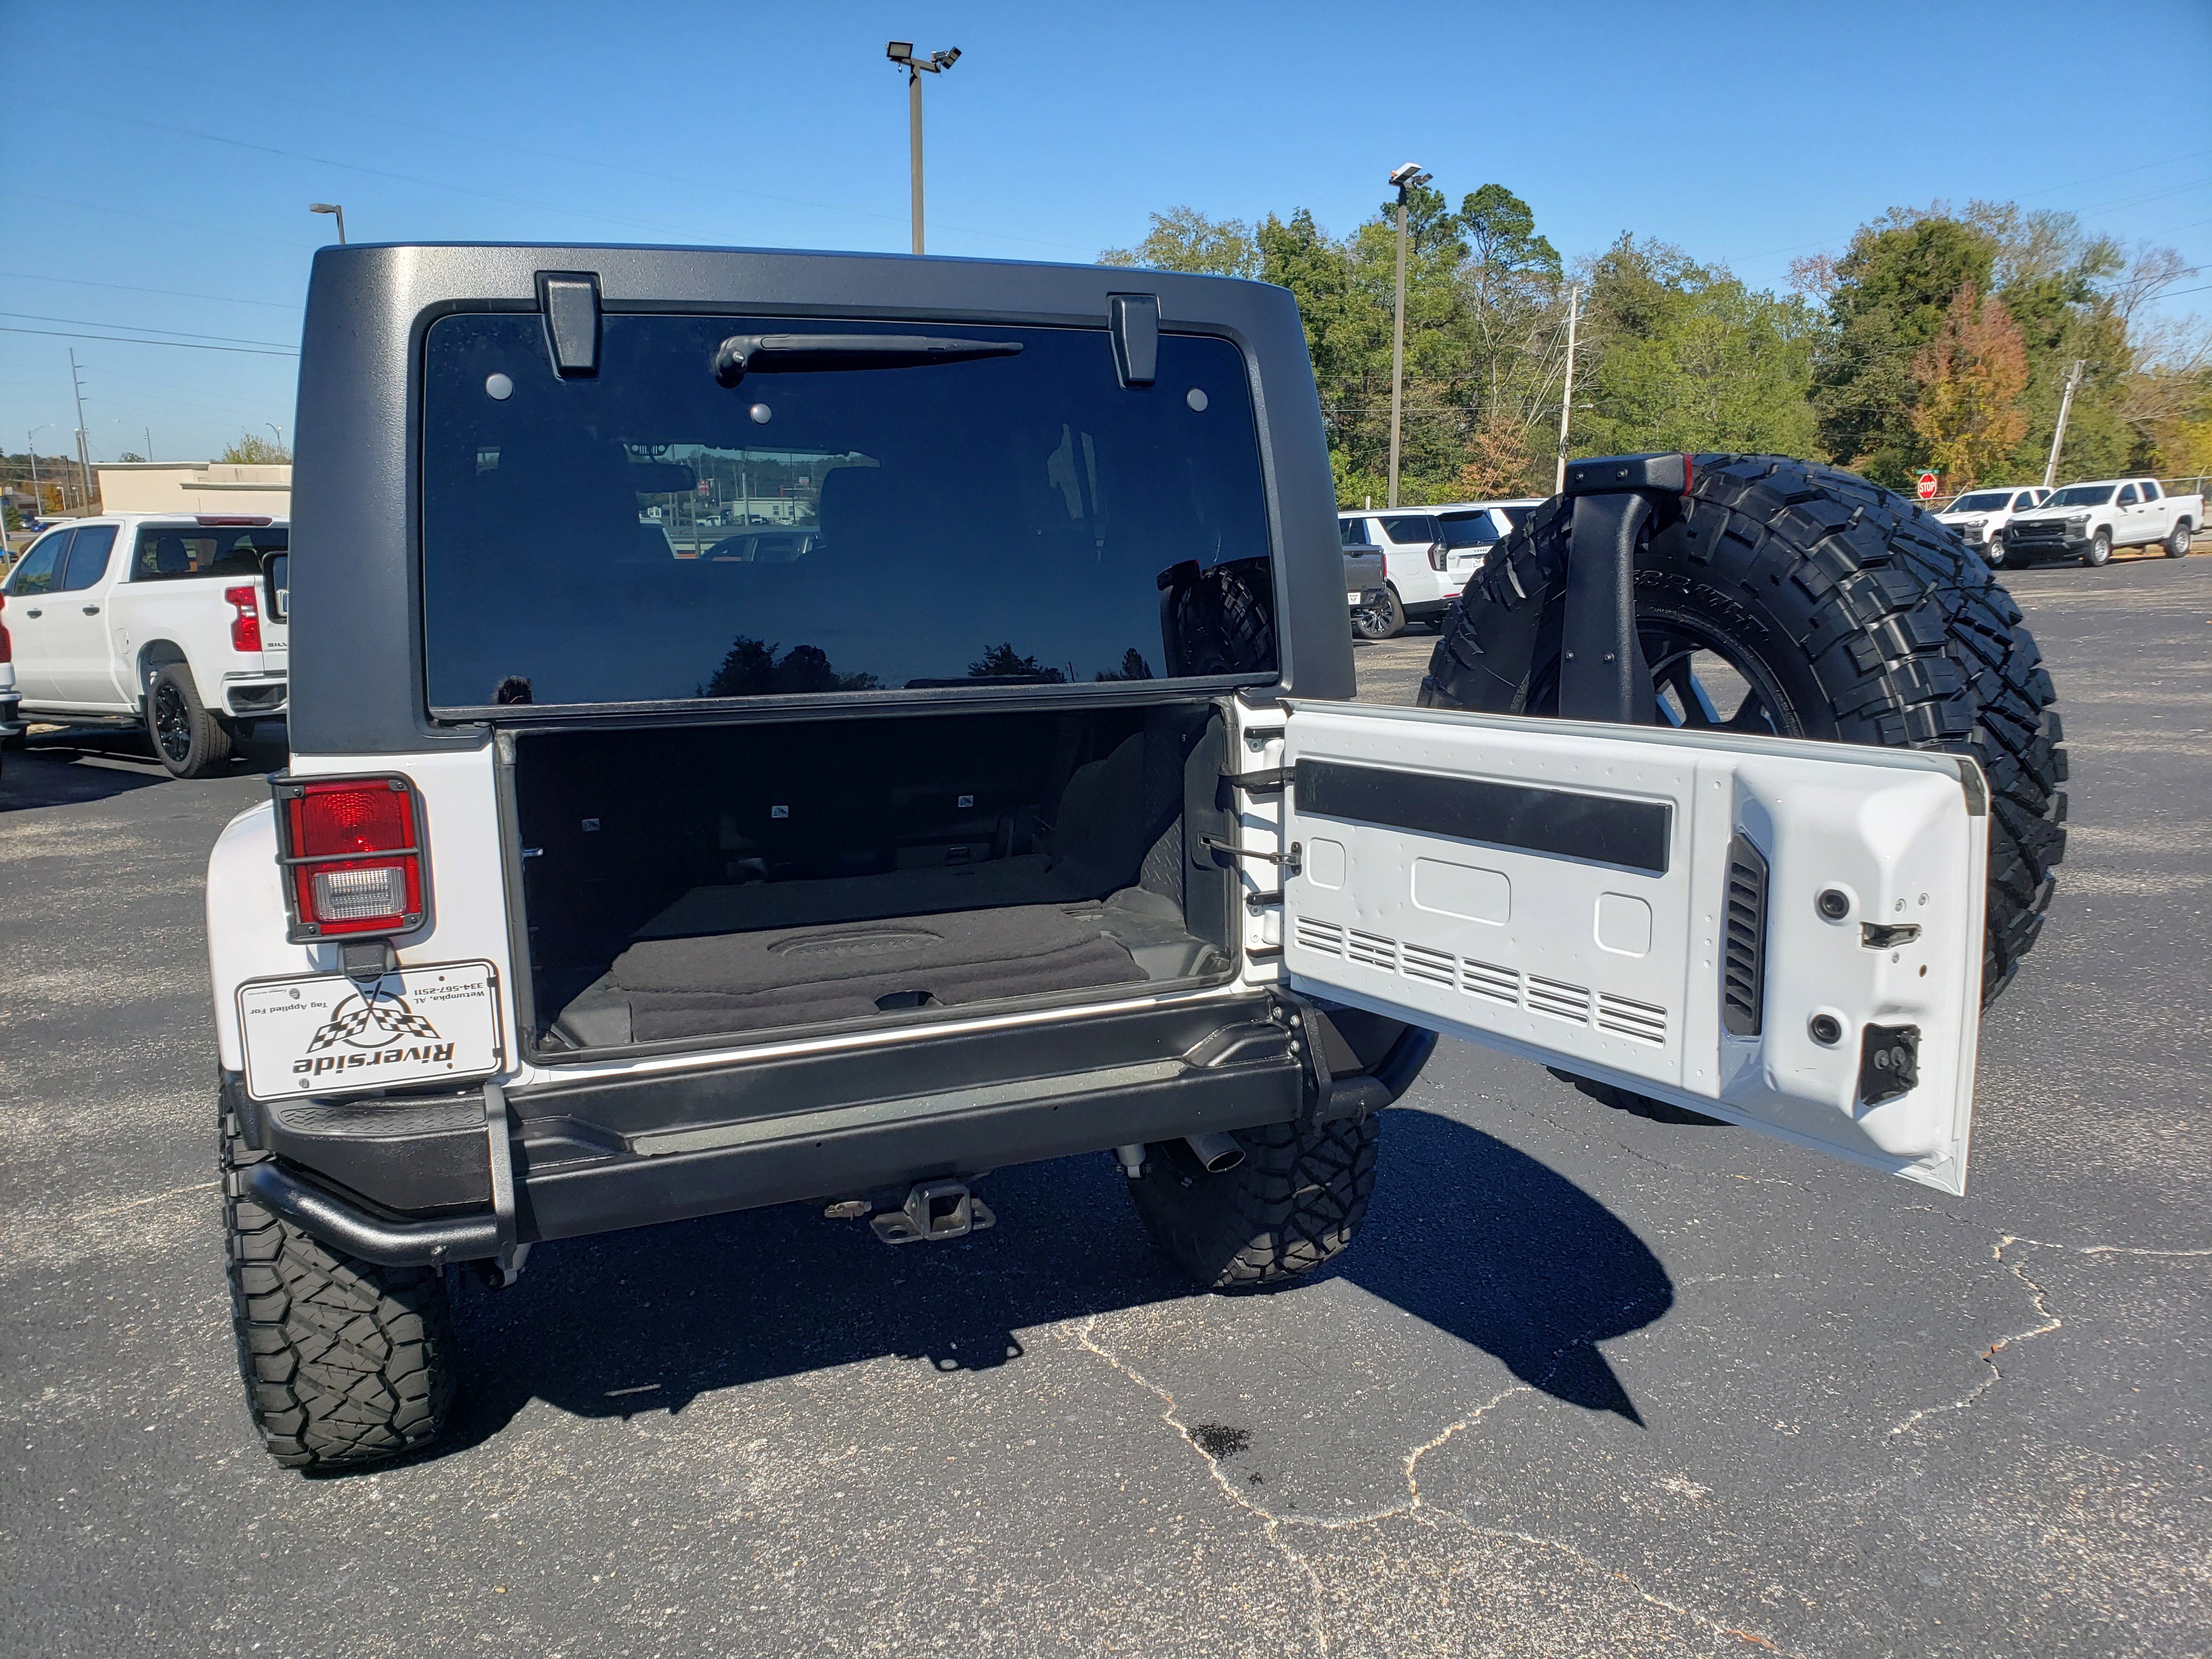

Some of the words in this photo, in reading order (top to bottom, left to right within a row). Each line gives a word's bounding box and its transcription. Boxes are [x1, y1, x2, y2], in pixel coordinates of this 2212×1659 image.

[1920, 481, 1935, 493] STOP
[414, 982, 484, 996] 334-567-2511
[430, 991, 486, 1002] Wetumpka,
[270, 1003, 307, 1013] Applied
[292, 1042, 455, 1076] Riverside
